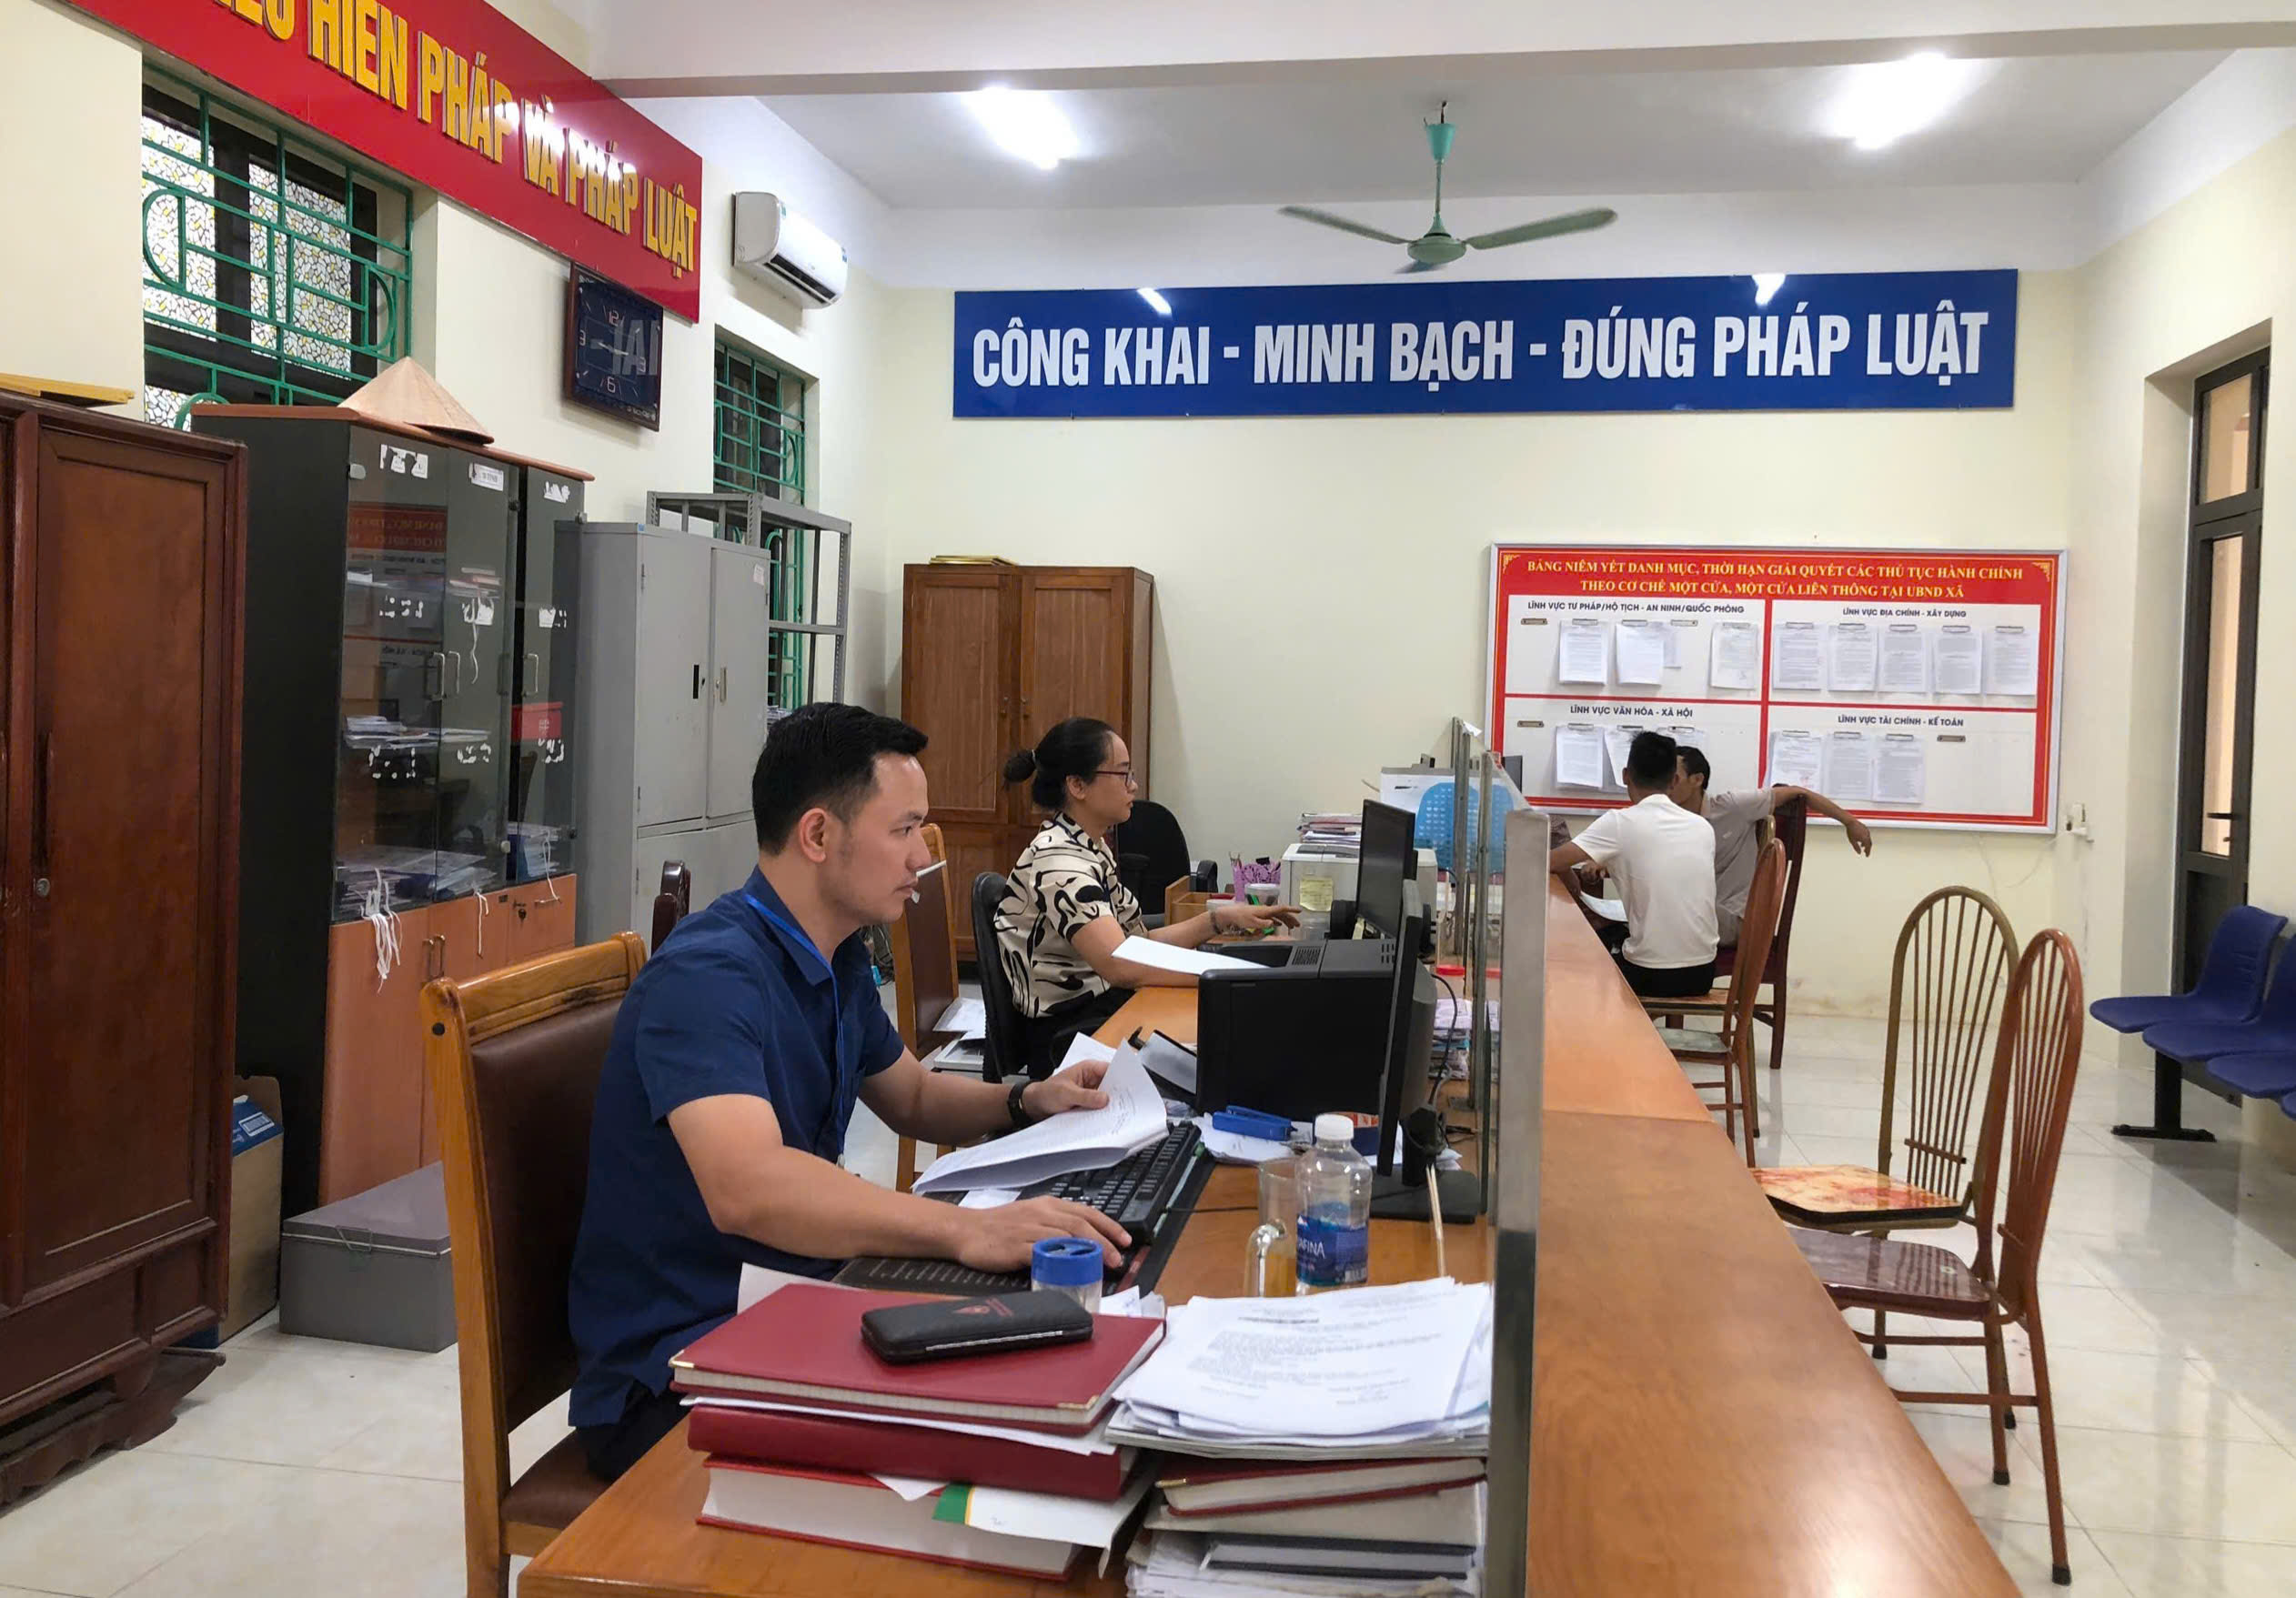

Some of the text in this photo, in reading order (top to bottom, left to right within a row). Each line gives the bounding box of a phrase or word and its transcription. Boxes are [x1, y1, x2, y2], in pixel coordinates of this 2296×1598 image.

[418, 30, 519, 165] PHÁP
[521, 95, 559, 196] VÀ
[563, 126, 638, 236] PHÁP
[643, 177, 697, 278] LUẬT
[972, 299, 1989, 392] CÔNG KHAI - MINH BẠCH - ĐÚNG PHÁP LUẬT
[607, 376, 616, 393] 6
[1527, 558, 1562, 572] BẢNG
[1565, 558, 1597, 573] NIÊM
[1628, 562, 1664, 574] DANH
[1667, 563, 1699, 577] MỤC,
[1737, 563, 1765, 578] HẠN
[1847, 563, 1874, 578] CÁC
[1908, 567, 1935, 580] TỤC
[1938, 564, 1976, 578] HÀNH
[1979, 566, 2023, 580] CHÍNH
[1580, 580, 1616, 591] THEO
[1618, 580, 1637, 592] CƠ
[1668, 580, 1699, 595] MỘT
[1735, 581, 1765, 596] MỘT
[1798, 581, 1828, 596] LIÊN
[1832, 582, 1878, 597] THÔNG
[1880, 585, 1903, 599] TẠI
[1907, 586, 1943, 598] UBND
[1945, 584, 1964, 598] XÃ
[1548, 602, 1566, 611] VỰC
[1620, 603, 1639, 613] TỊCH
[1895, 608, 1920, 617] CHÍNH
[1592, 706, 1611, 716] VỰC
[1613, 705, 1632, 715] VĂN
[1634, 706, 1654, 716] HÓA
[1677, 707, 1693, 719] HỘI
[1858, 716, 1877, 726] VỰC
[1893, 716, 1921, 726] CHÍNH
[1940, 717, 1964, 727] TOÁN
